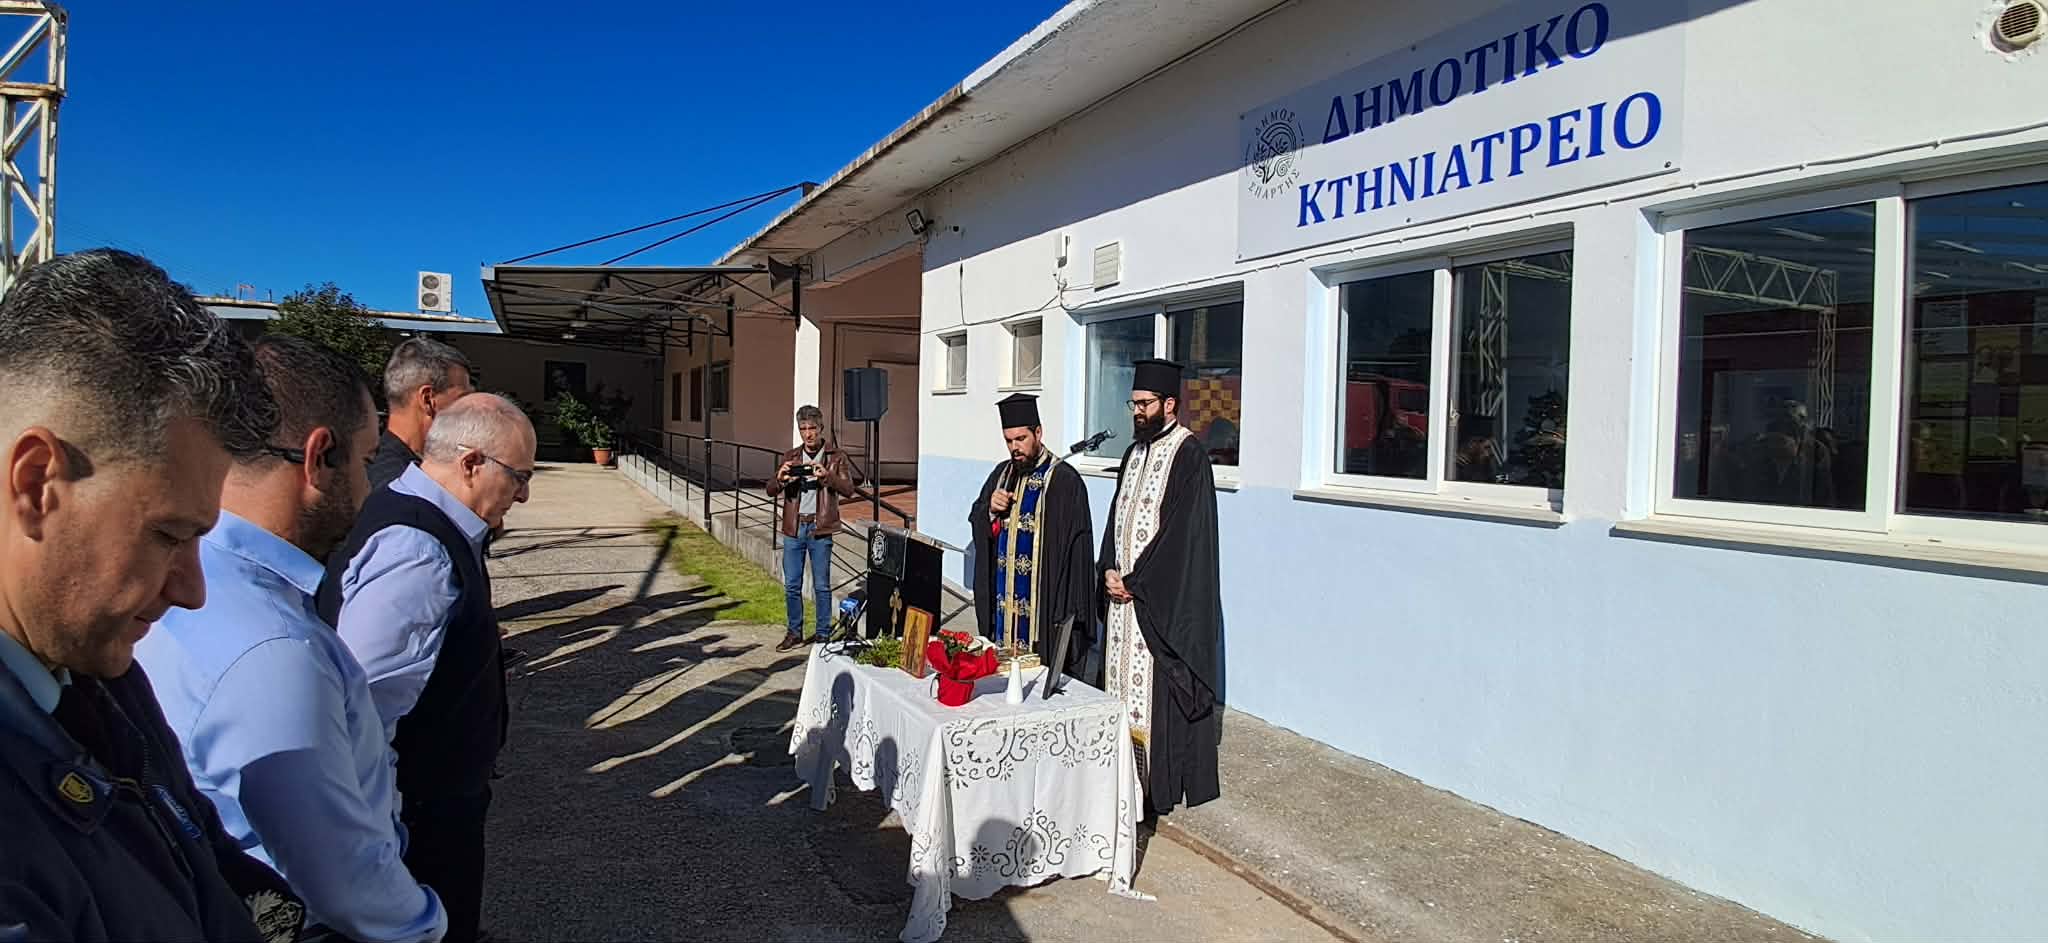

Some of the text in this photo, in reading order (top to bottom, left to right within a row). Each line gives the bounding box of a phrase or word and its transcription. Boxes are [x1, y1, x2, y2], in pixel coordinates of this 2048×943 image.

[1322, 2, 1609, 144] ΔΗΜΟΤΙΚΟ
[1255, 108, 1295, 136] ΔΗΜΟΣ
[1297, 91, 1661, 227] ΚΤΗΝΙΑΤΡΕΙΟ
[1248, 168, 1300, 200] ΣΠΑΡΤΗΣ
